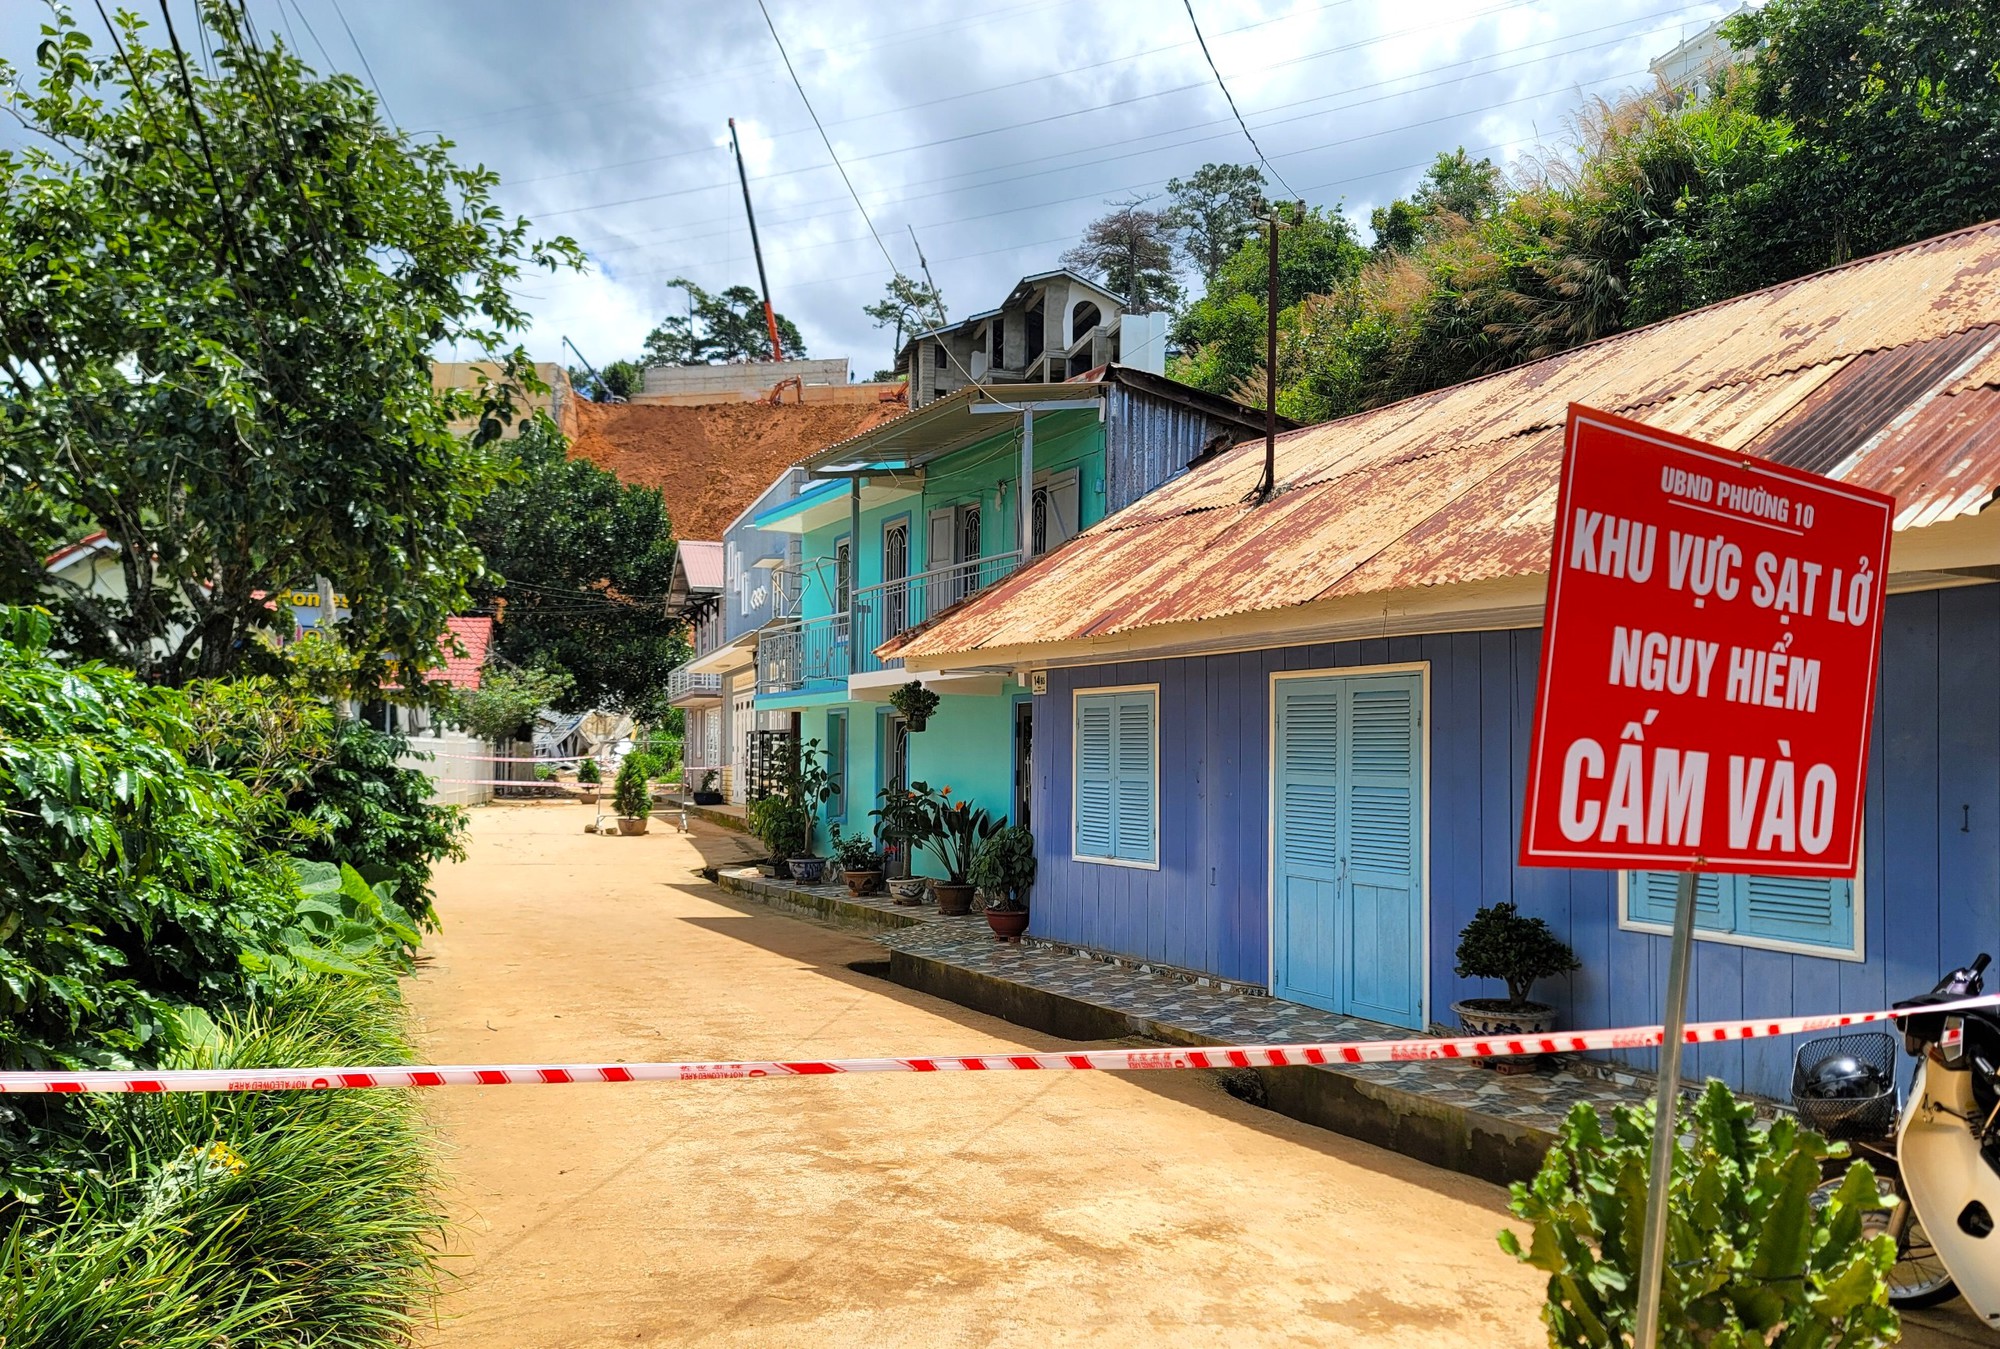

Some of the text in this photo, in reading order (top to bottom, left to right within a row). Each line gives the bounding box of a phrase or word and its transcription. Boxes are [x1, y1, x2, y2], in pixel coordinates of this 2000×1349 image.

[1661, 465, 1815, 529] UBND PHƯỜNG 10
[1569, 506, 1874, 627] KHU VỰC SẠT LỞ
[1608, 625, 1822, 713] NGUY HIỂM
[1558, 708, 1838, 855] CẤM VÀO
[228, 1080, 307, 1091] NOT ALLOWED AREA
[680, 1072, 697, 1080] AREA
